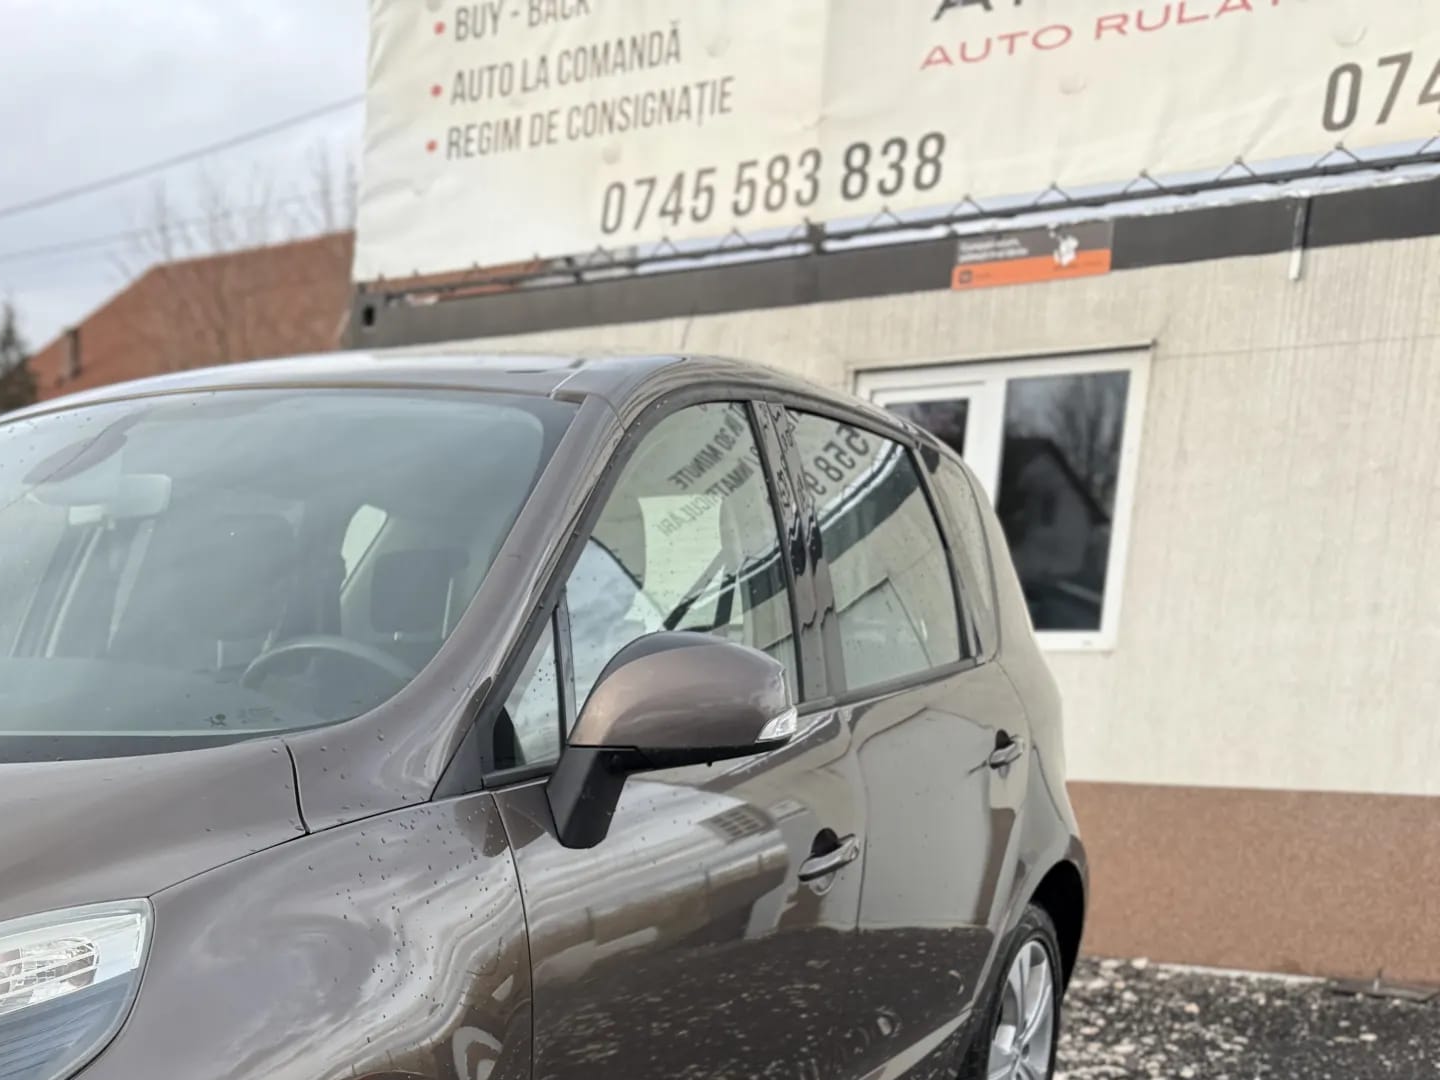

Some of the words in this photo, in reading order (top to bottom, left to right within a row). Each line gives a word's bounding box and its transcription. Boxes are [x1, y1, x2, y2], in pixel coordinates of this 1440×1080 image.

[455, 0, 505, 41] BUY
[920, 24, 1073, 70] AUTO
[450, 62, 514, 105] AUTO
[521, 55, 549, 93] LA
[557, 21, 681, 85] COMANDĂ
[446, 116, 522, 160] REGIM
[529, 110, 559, 148] DE
[566, 76, 735, 141] CONSIGNAȚIE
[600, 167, 717, 234] 0745
[732, 148, 822, 216] 583
[841, 132, 946, 201] 838
